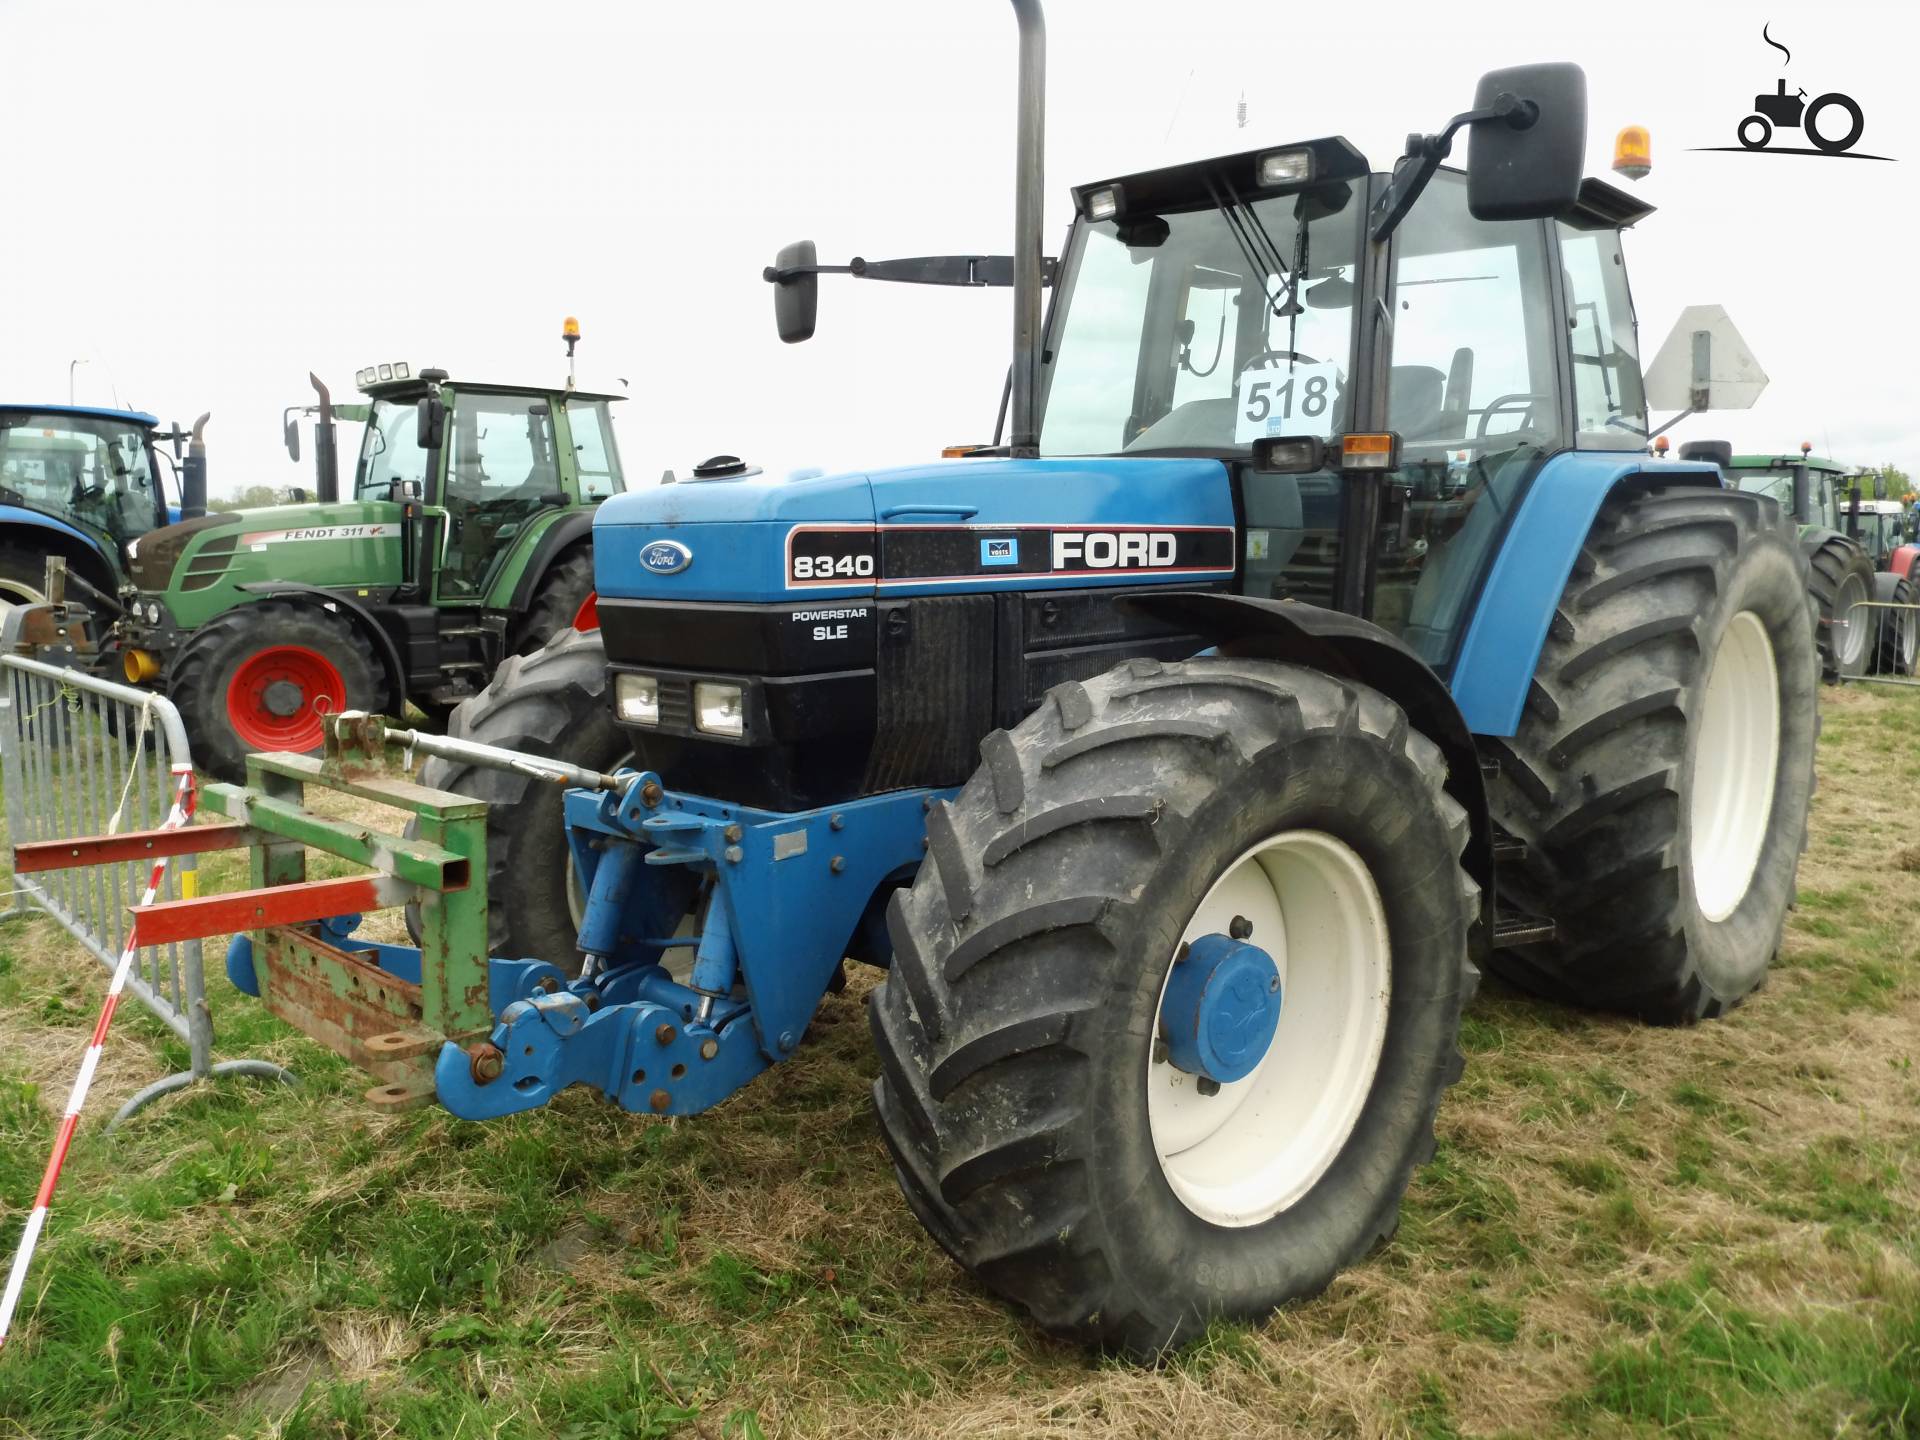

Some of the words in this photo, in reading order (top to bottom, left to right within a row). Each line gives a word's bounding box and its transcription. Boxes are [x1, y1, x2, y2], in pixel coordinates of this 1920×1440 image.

[1246, 376, 1327, 422] 518
[284, 528, 336, 540] FENDT
[341, 527, 364, 537] 311
[649, 547, 675, 567] Ford
[1053, 533, 1176, 569] FORD
[794, 555, 874, 578] 8340
[792, 608, 867, 622] POWERSTAR
[813, 625, 848, 641] SLE
